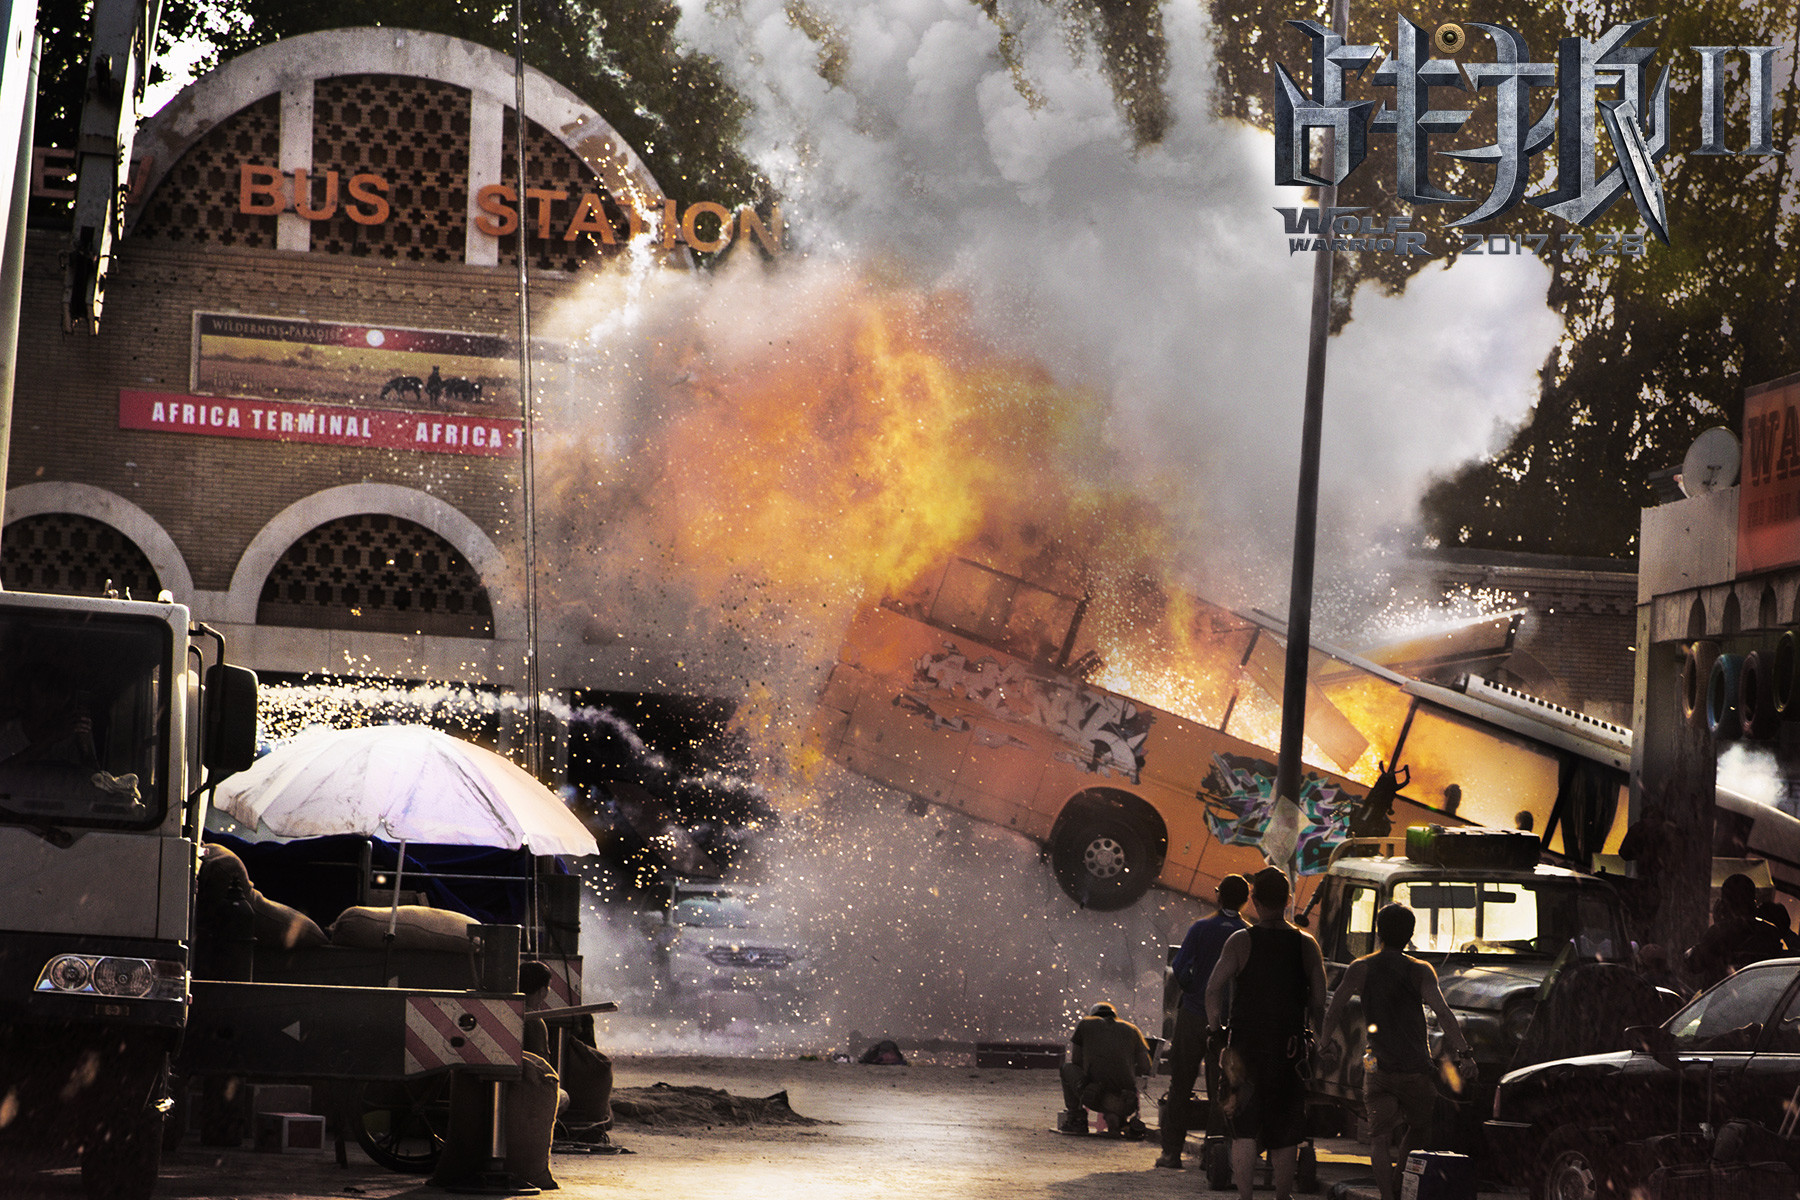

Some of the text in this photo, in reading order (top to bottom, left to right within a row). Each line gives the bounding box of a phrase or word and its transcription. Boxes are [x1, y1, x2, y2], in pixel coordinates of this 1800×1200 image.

[239, 163, 390, 225] BUS
[474, 184, 785, 254] STATION
[152, 402, 372, 438] AFRICA TERMINAL
[415, 422, 502, 448] AFRICA
